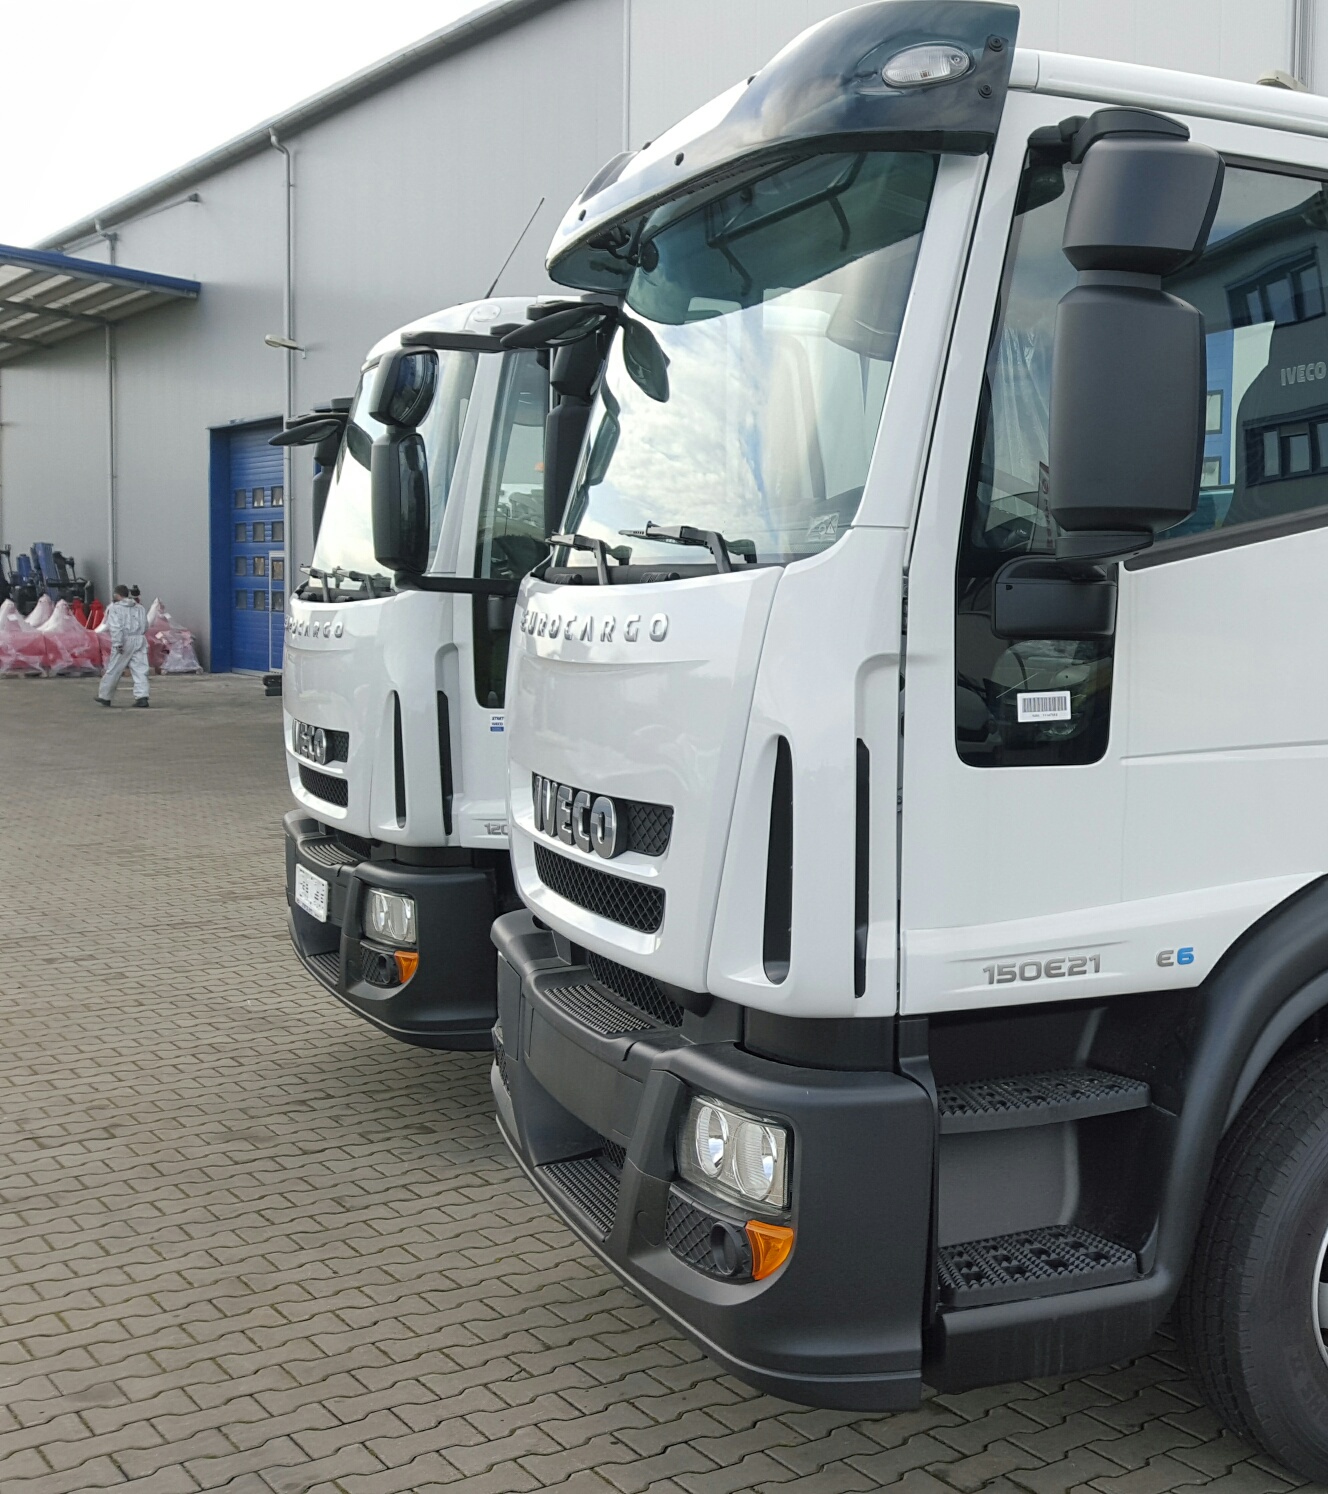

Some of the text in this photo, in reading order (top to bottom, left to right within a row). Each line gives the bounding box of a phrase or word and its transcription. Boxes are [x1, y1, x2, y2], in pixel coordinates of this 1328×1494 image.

[1281, 361, 1327, 386] IVECO
[285, 615, 344, 639] ROCARGO
[520, 609, 669, 643] EUROCARGO
[292, 718, 327, 765] IVECO
[532, 775, 617, 859] IVECO
[983, 954, 1101, 985] 150E21
[1156, 947, 1195, 968] E6
